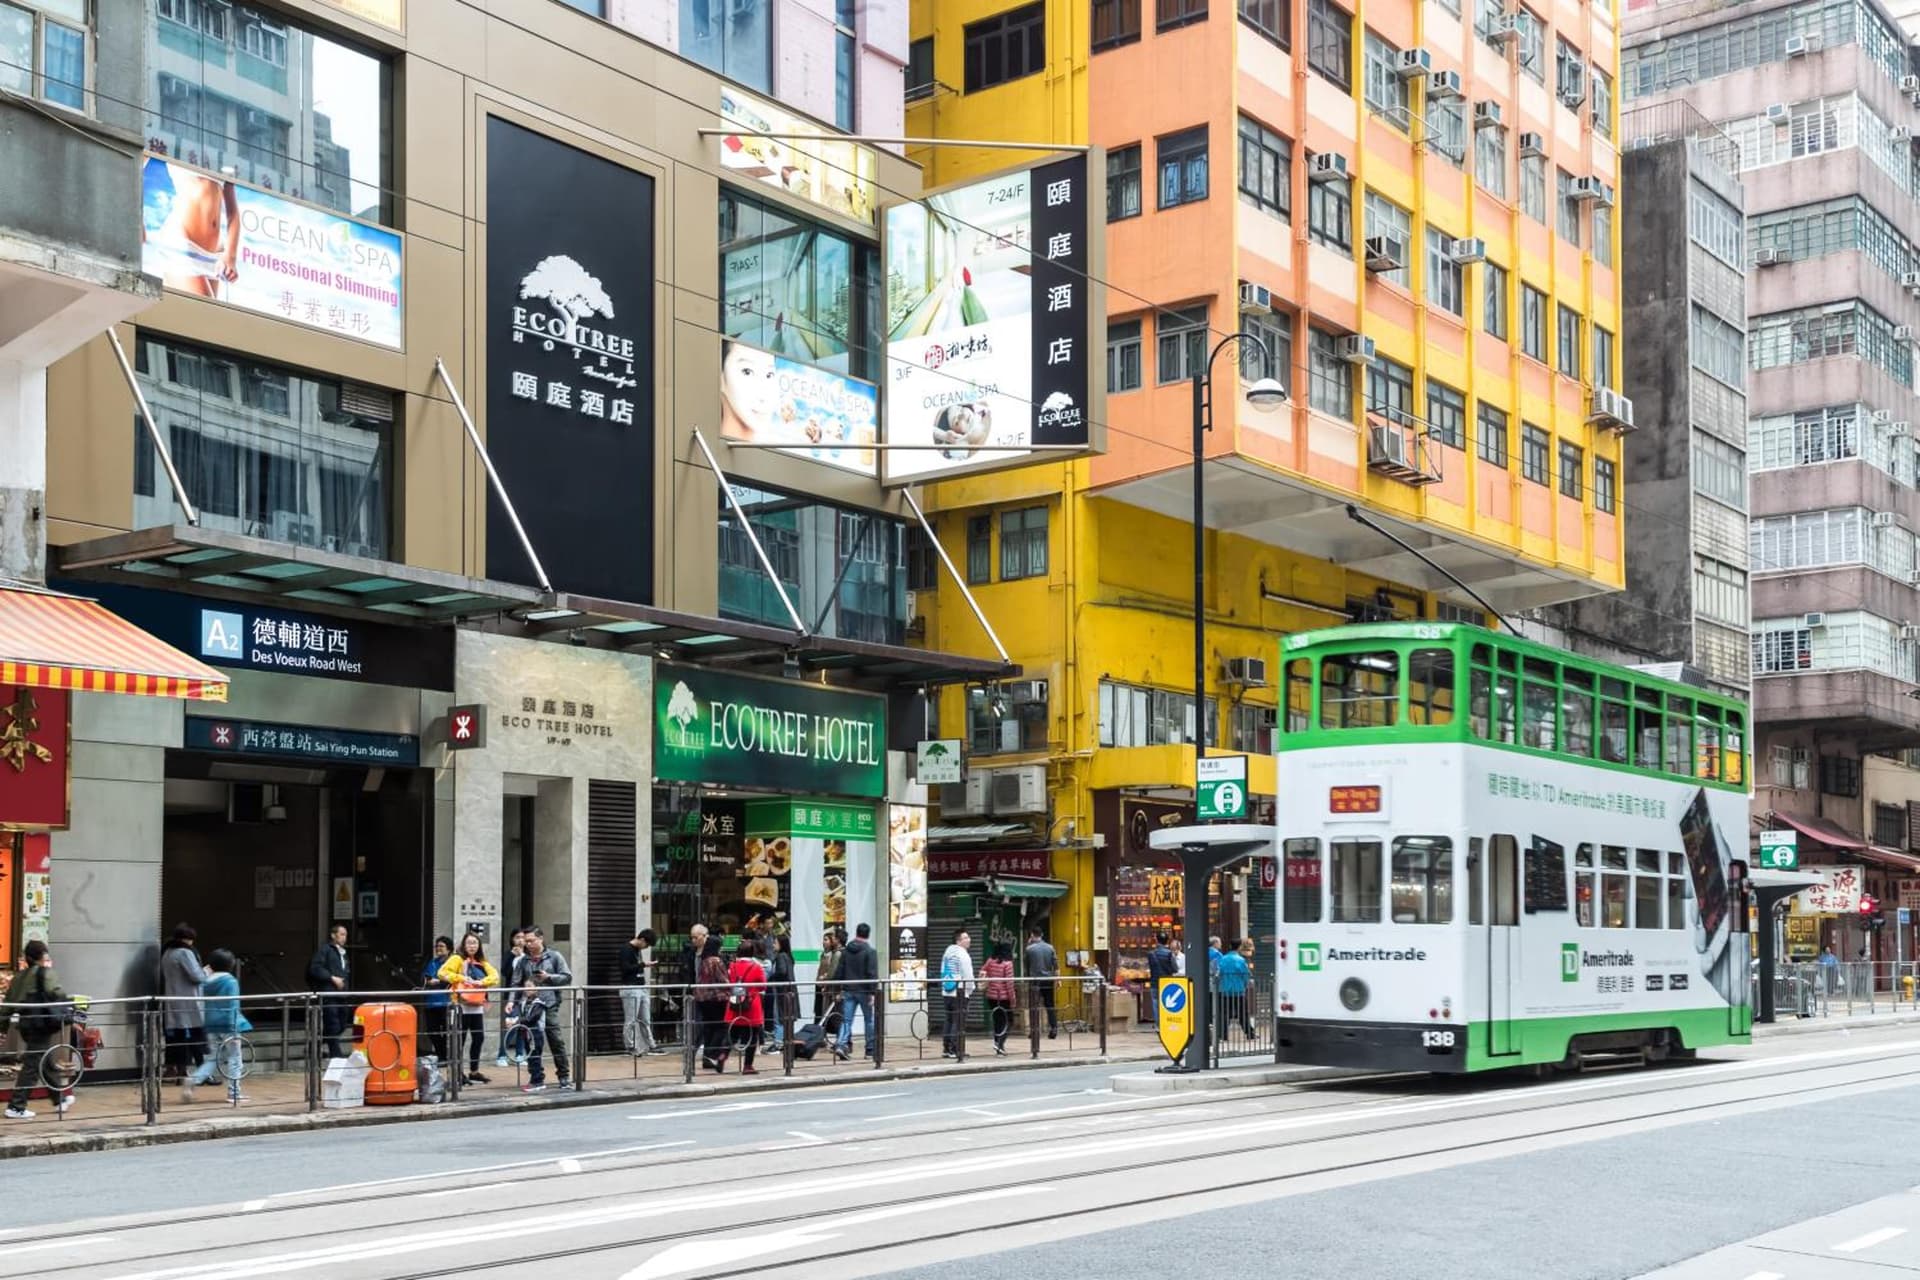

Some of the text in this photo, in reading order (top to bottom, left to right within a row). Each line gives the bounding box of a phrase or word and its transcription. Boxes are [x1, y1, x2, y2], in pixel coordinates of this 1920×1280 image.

[987, 184, 1024, 205] 7-24/F
[242, 208, 393, 274] OCEAN SPA
[242, 247, 398, 307] Professional Slimming
[1047, 178, 1073, 366] 頤庭酒店
[277, 290, 371, 334] 專業塑形
[512, 371, 634, 425] 頤庭酒店
[779, 374, 830, 405] OCEAN
[923, 383, 999, 410] OCEAN SPA
[207, 619, 239, 651] A2
[252, 618, 349, 655] 德輔道西
[252, 650, 362, 674] Des Voeux Road West
[242, 728, 312, 751] 西營盤站
[502, 715, 613, 737] ECO TREE HOTEL
[710, 700, 879, 766] ECOTREE HOTEL
[315, 742, 399, 758] Sai Ying Pun Station
[1559, 787, 1606, 811] Ameritrade
[1301, 948, 1427, 966] TD Ameritrade
[1565, 950, 1634, 975] TD Ameritrade
[1421, 1031, 1454, 1047] 138
